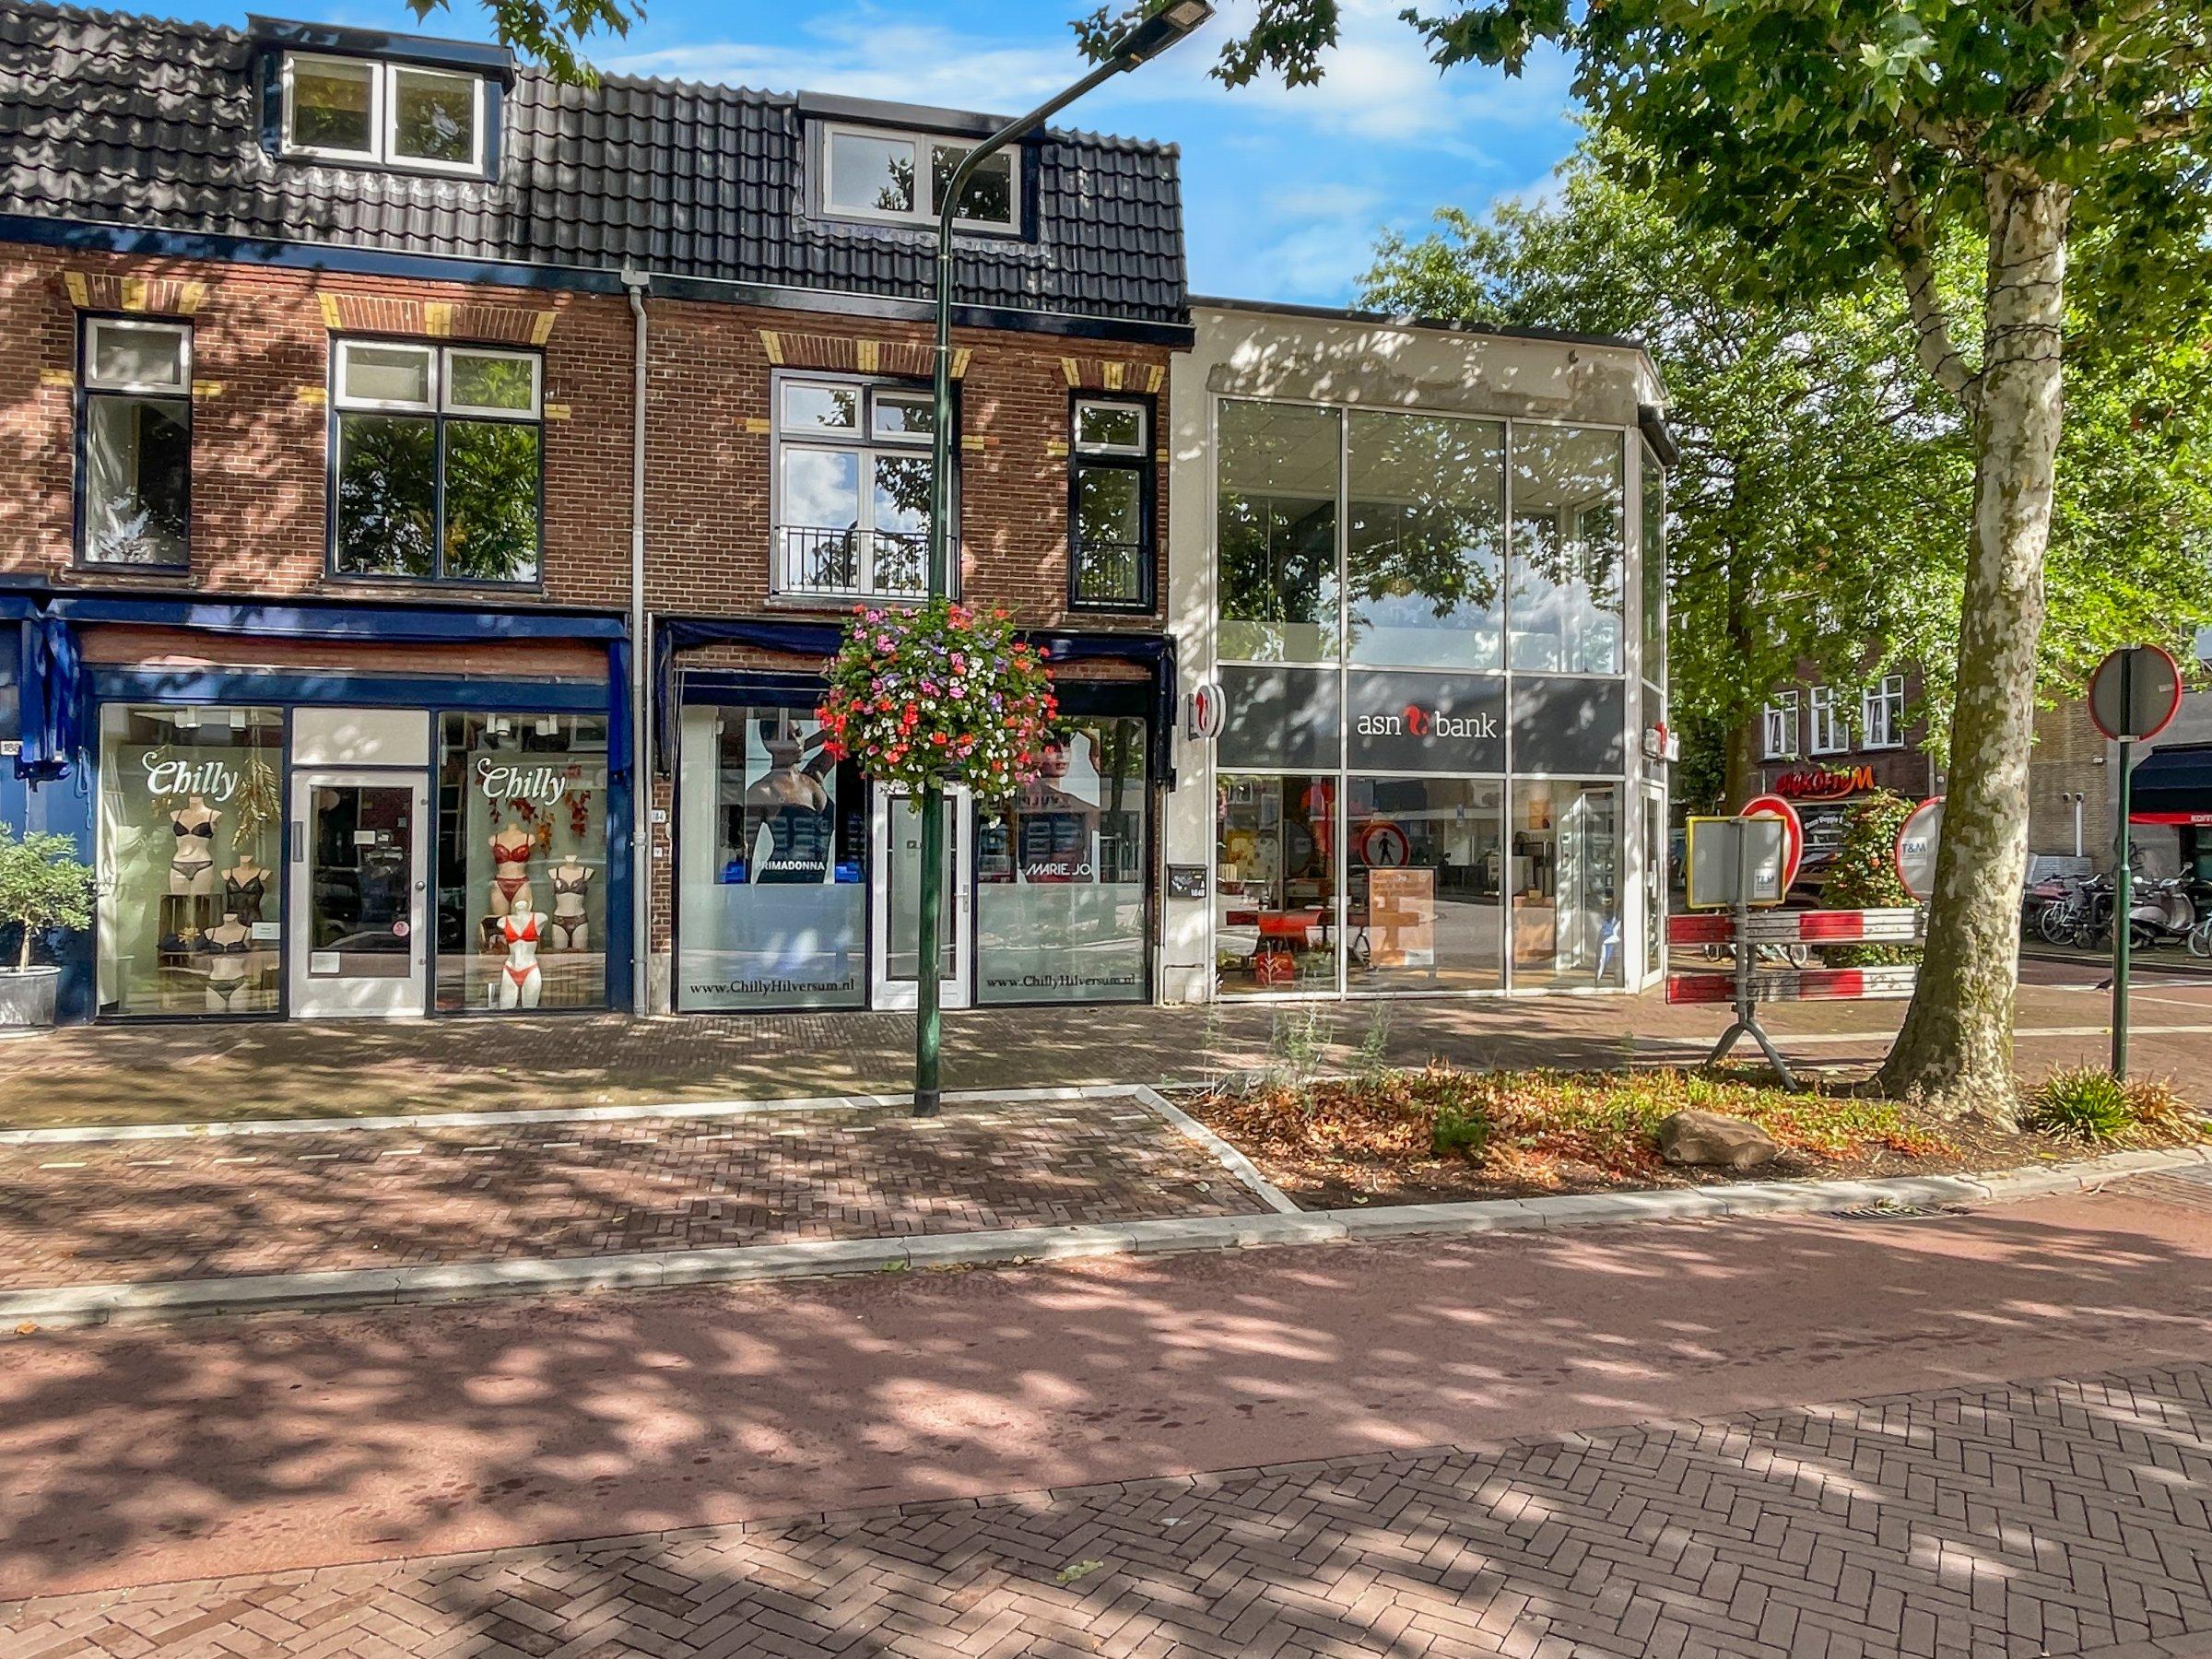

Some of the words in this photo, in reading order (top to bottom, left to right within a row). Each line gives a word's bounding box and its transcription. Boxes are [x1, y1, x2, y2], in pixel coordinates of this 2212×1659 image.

[1357, 714, 1402, 735] asn
[1434, 711, 1497, 737] bank
[142, 751, 239, 802] Chilly
[477, 757, 566, 806] Chilly
[1902, 842, 1926, 854] T&M
[1026, 863, 1070, 876] MARIE
[1072, 863, 1091, 876] JO
[690, 978, 854, 996] www.ChillyHilversum.nl
[986, 973, 1135, 990] www.ChillyHilversum.nl
